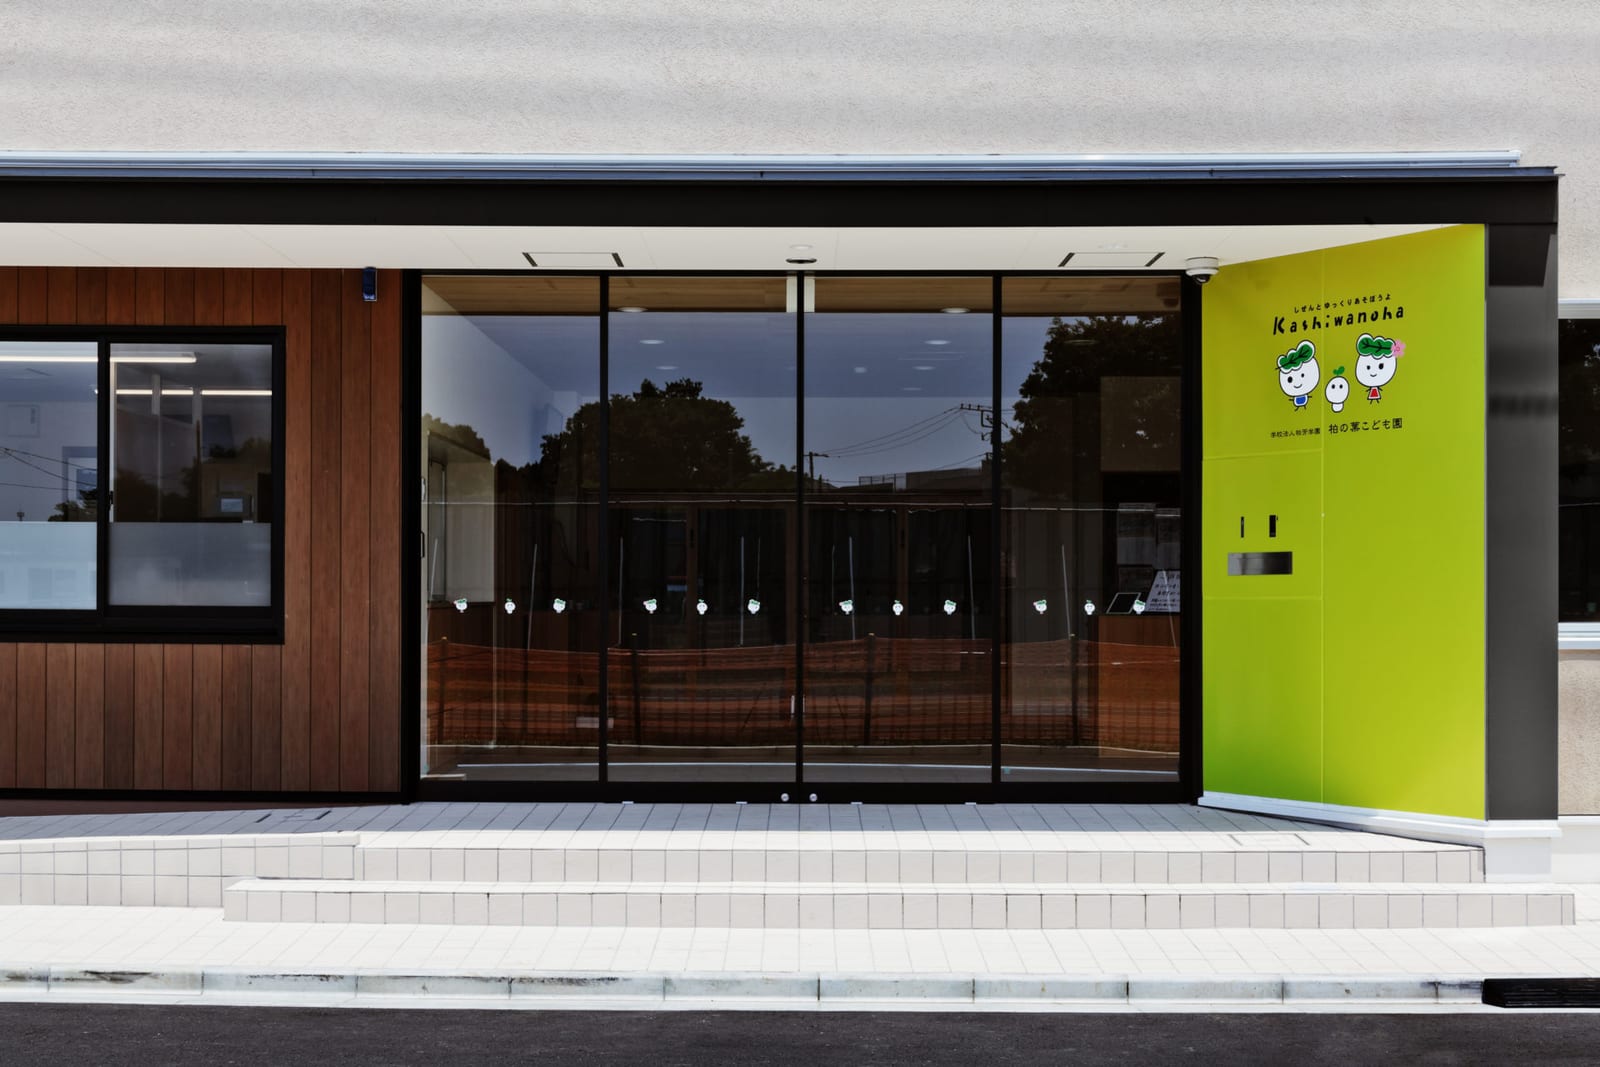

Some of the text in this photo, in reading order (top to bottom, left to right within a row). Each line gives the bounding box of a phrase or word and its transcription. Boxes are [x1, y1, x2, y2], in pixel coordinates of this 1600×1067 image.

[1273, 306, 1404, 335] Kashiwanoha
[1328, 418, 1403, 434] 柏の葉こども園
